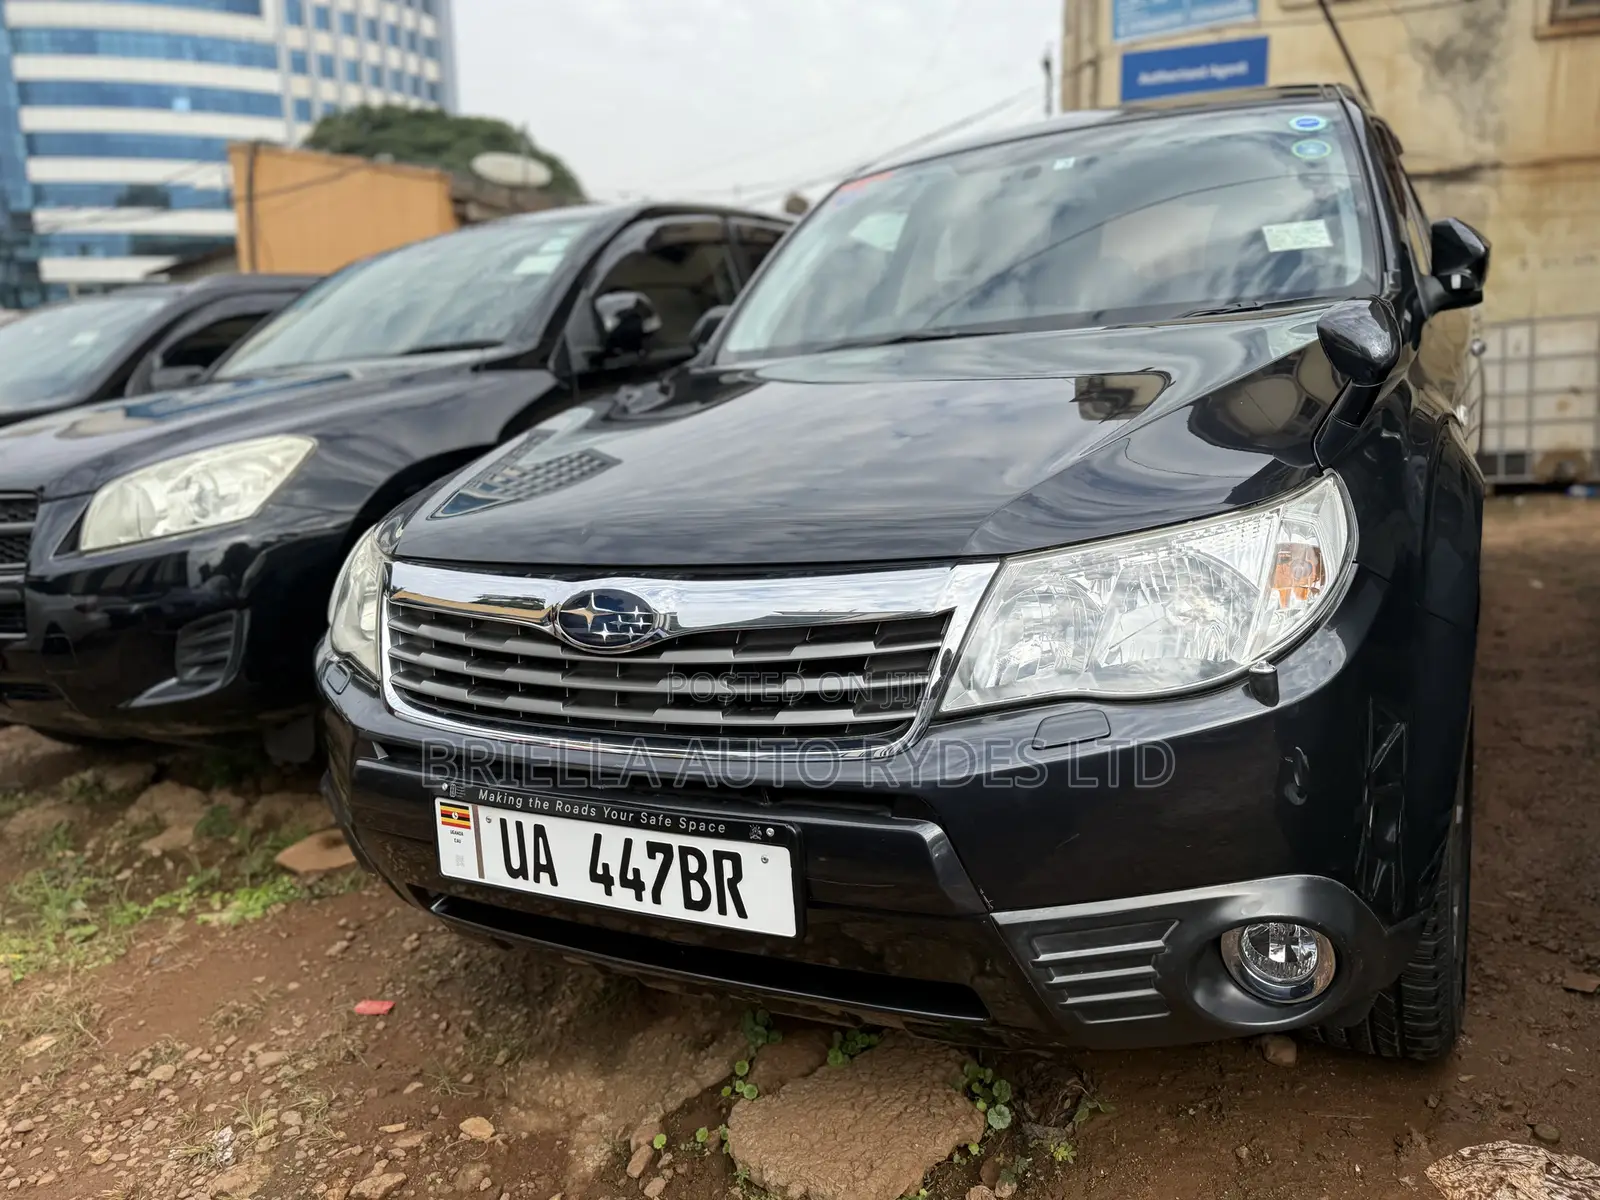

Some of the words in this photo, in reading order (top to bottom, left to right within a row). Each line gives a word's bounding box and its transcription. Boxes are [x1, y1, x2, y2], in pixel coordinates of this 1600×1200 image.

[478, 788, 523, 809] Making
[528, 795, 549, 810] the
[555, 799, 597, 817] Roads
[602, 806, 634, 823] Your
[640, 812, 671, 828] Safe
[679, 818, 726, 834] Space
[500, 817, 558, 887] UA
[589, 832, 748, 919] 447BR
